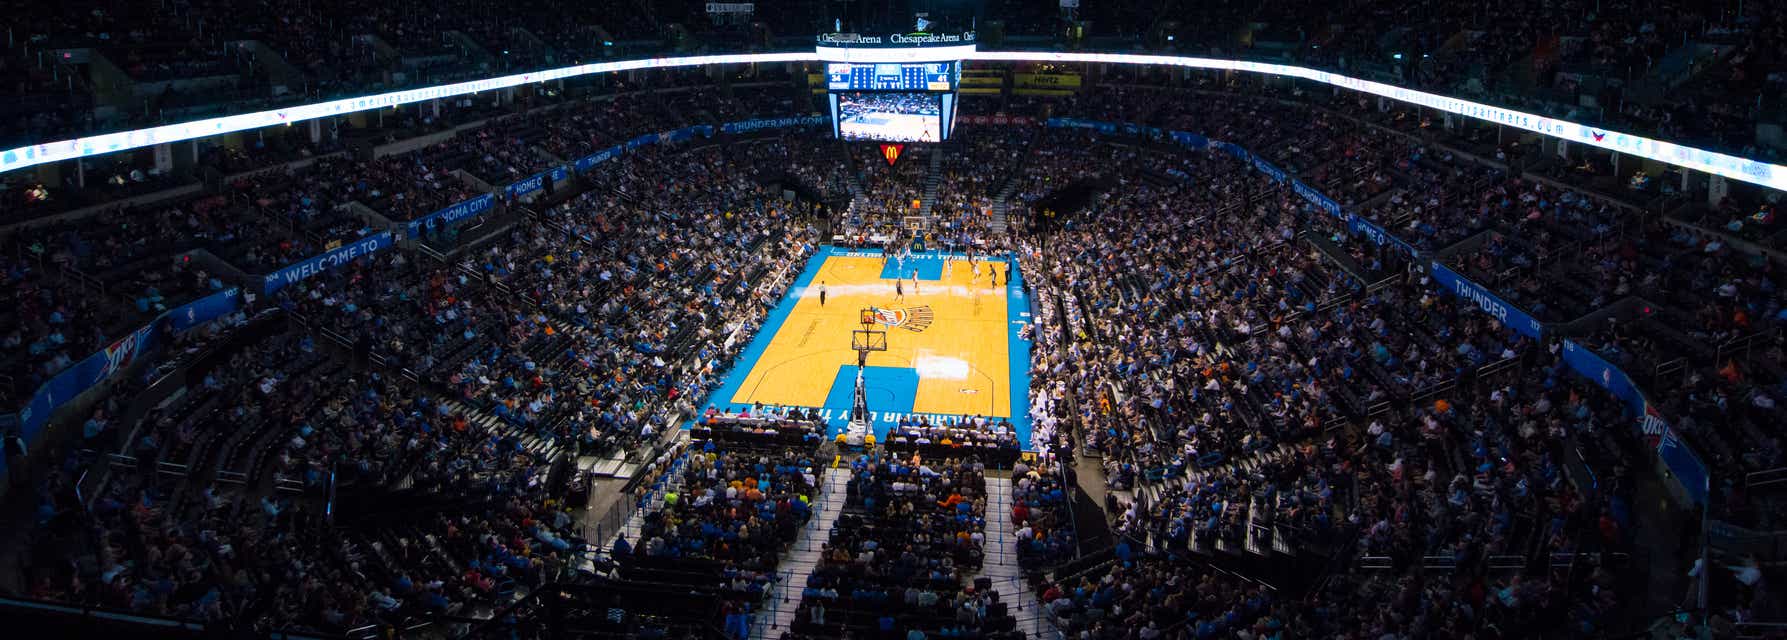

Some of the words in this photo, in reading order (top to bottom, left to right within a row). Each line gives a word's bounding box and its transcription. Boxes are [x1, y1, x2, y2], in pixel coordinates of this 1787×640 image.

[857, 34, 881, 44] Arena
[890, 32, 940, 46] Chesapeake
[940, 33, 960, 42] Arena
[470, 197, 489, 213] CITY
[285, 248, 357, 284] WELCOME
[361, 239, 378, 255] TO
[1455, 279, 1508, 324] THUNDER
[1642, 414, 1664, 435] OKC
